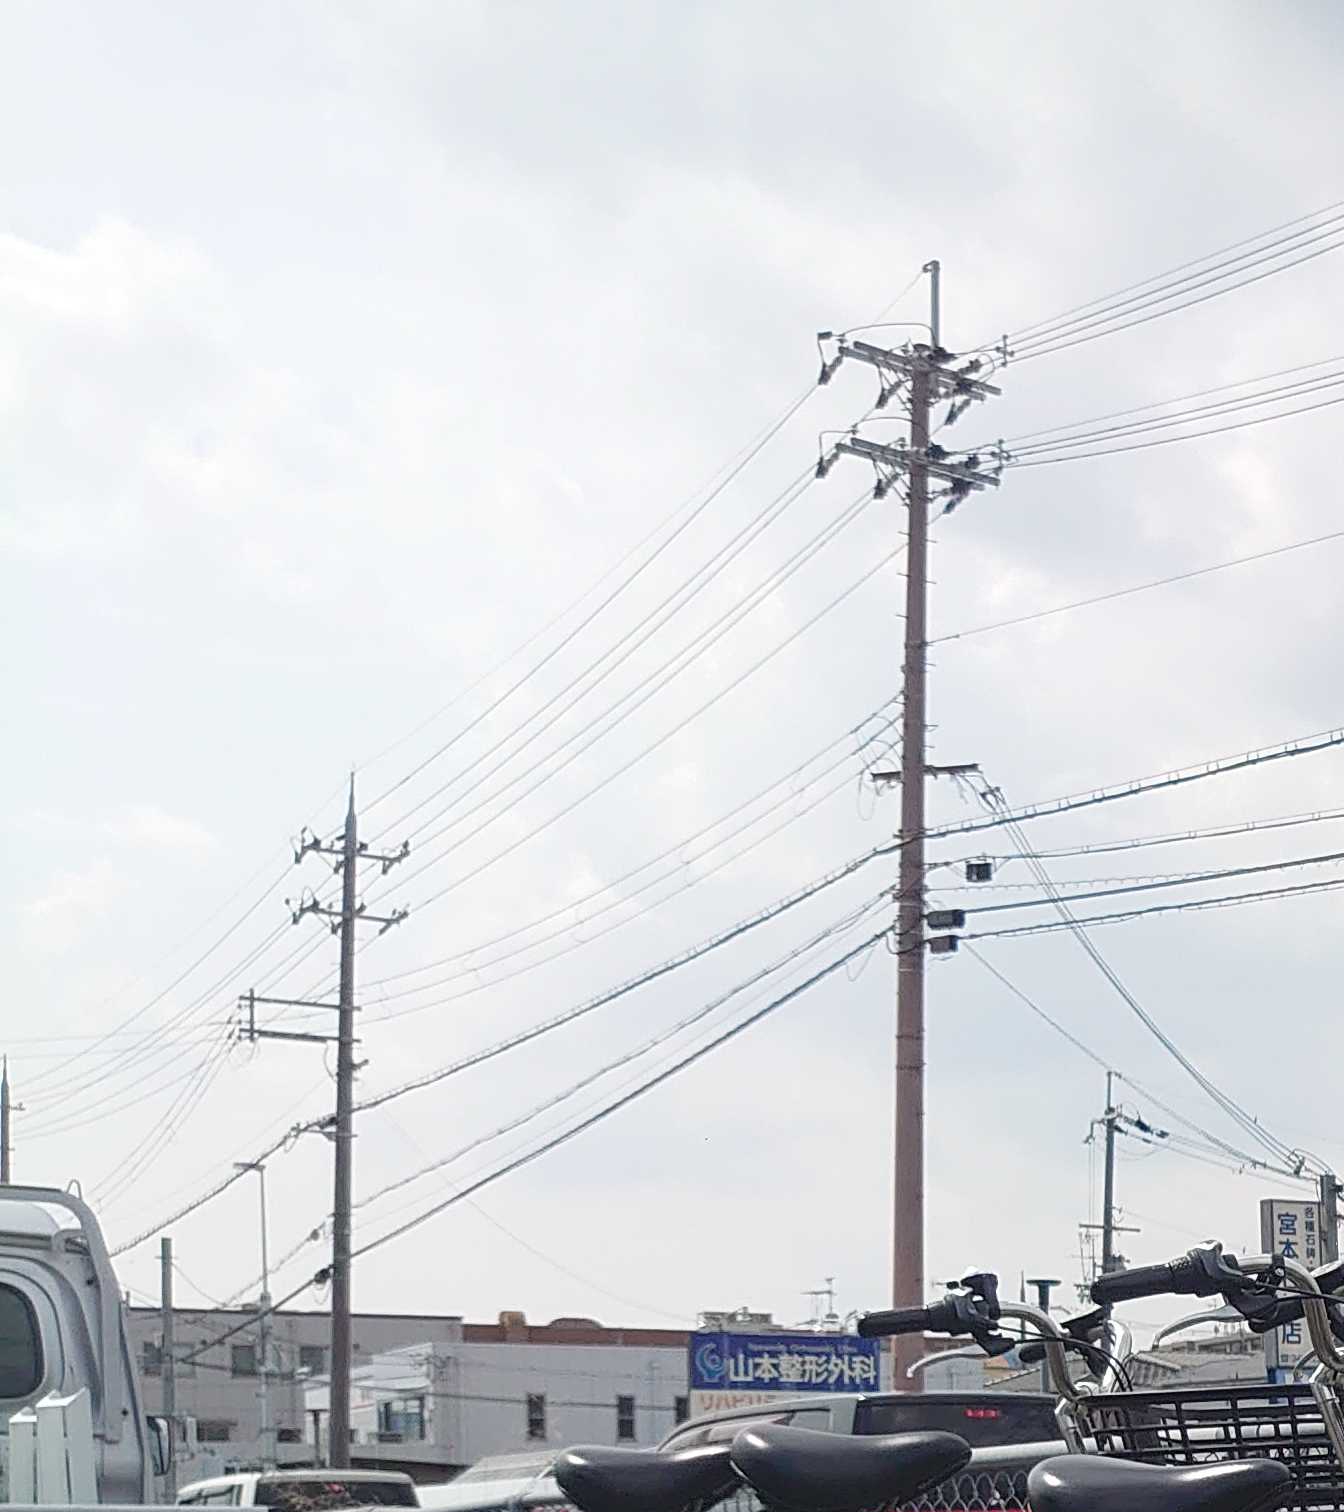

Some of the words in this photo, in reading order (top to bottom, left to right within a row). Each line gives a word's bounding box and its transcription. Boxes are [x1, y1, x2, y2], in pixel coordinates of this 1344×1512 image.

[729, 1354, 877, 1384] 山本整形外科
